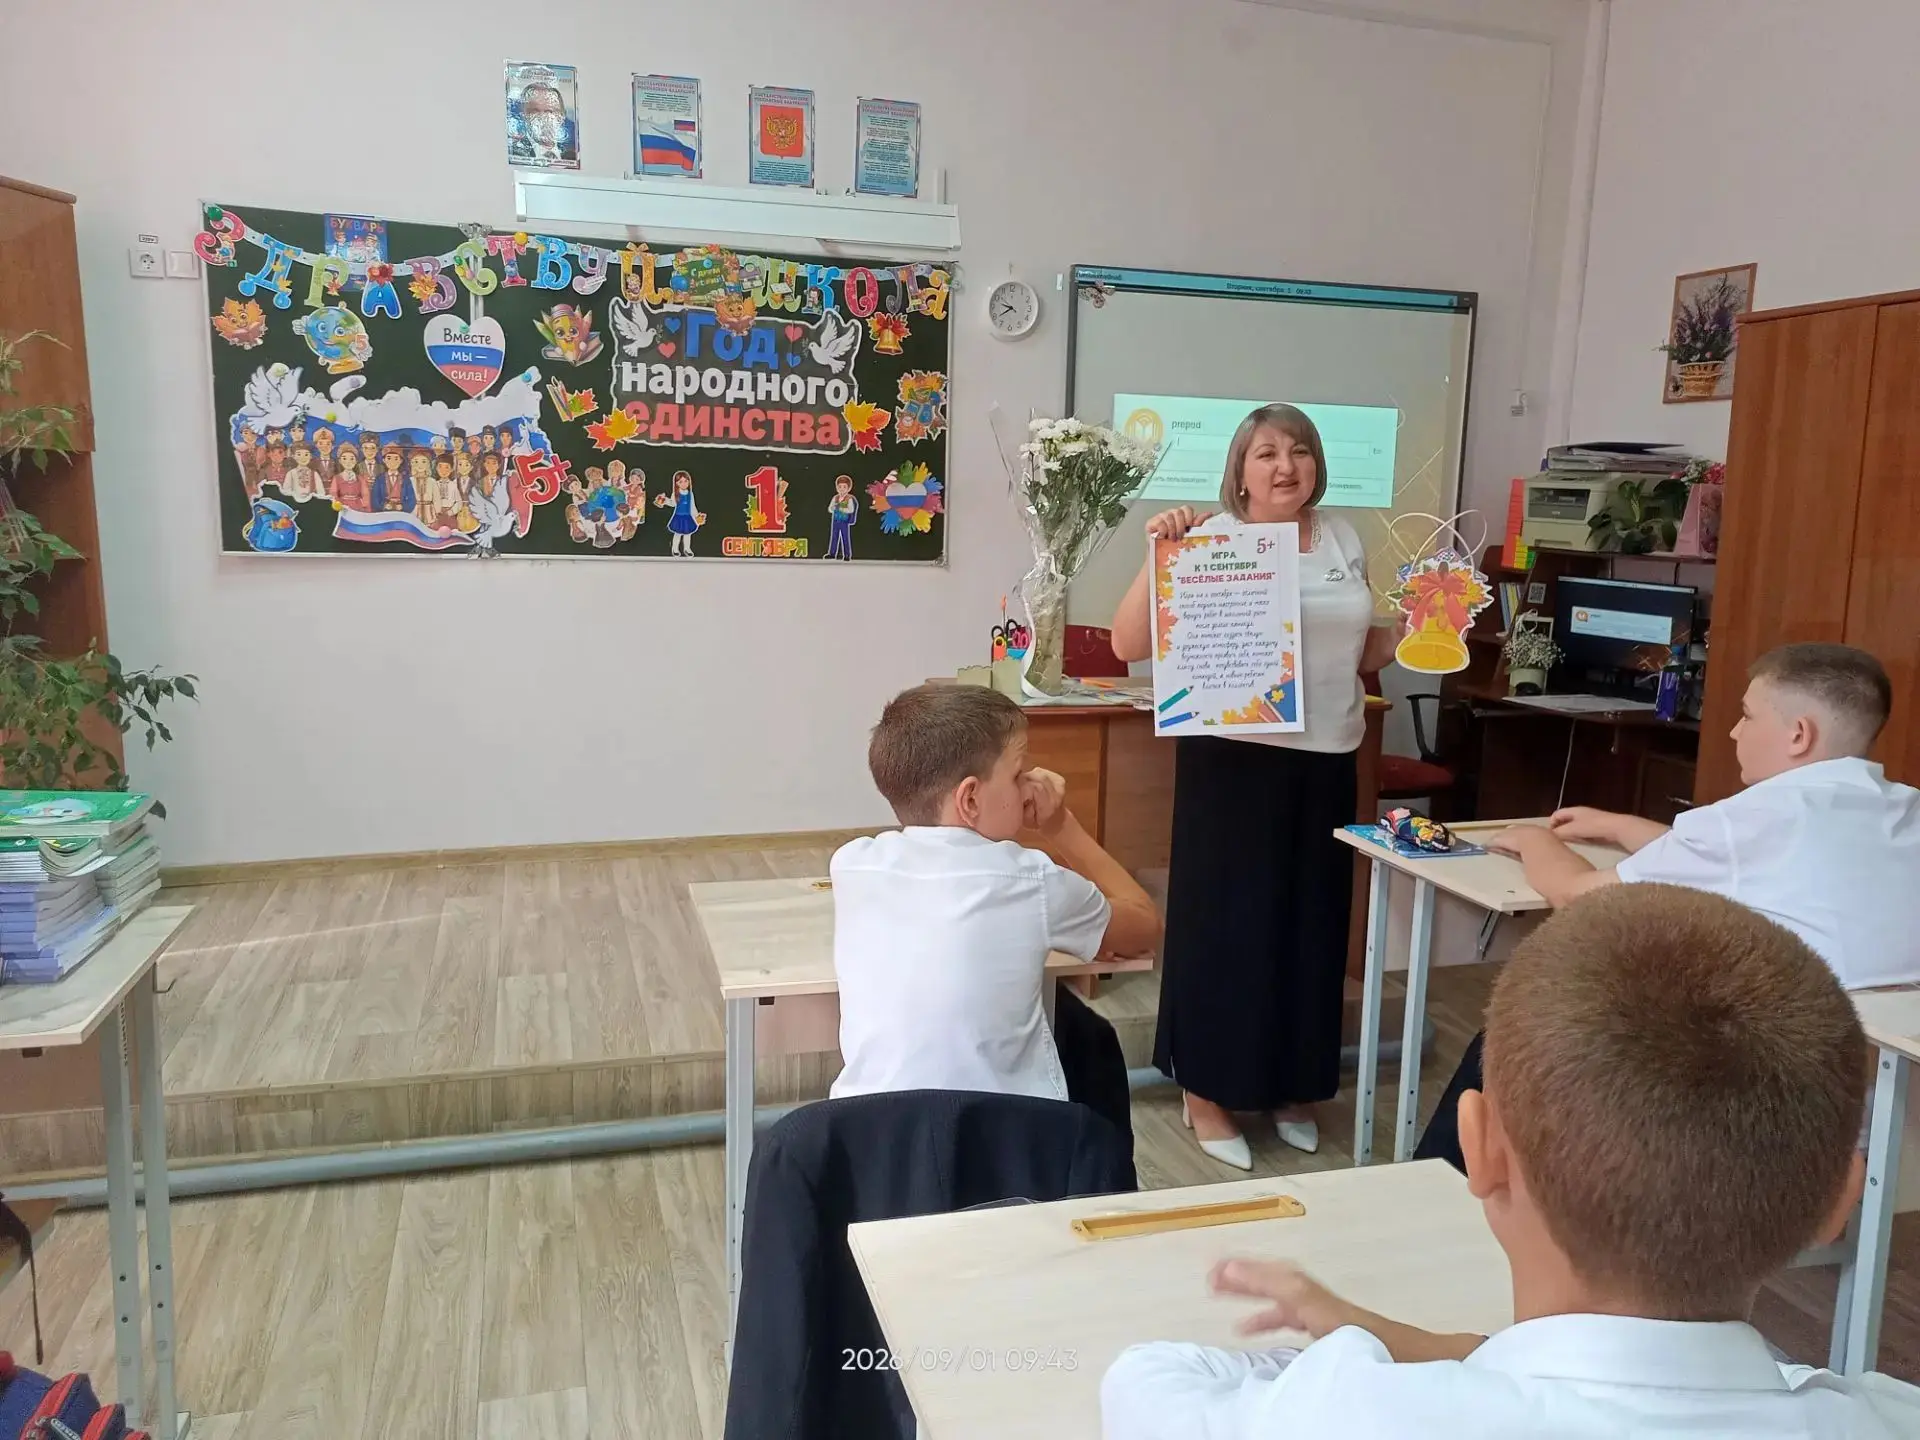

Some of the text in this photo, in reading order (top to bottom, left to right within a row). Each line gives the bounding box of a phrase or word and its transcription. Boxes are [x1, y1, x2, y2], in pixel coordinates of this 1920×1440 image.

[330, 217, 384, 233] БУКВАРЬ
[443, 327, 492, 346] Вместе
[683, 310, 779, 369] Год
[451, 350, 473, 363] мы
[450, 368, 488, 385] сила!
[621, 362, 850, 407] народного
[624, 400, 842, 447] единства
[745, 466, 789, 534] 1
[722, 537, 808, 557] СЕНТЯБРЯ
[1256, 537, 1276, 554] 5+
[1210, 562, 1257, 571] СЕНТЯБРЯ
[1226, 572, 1276, 582] ЗАДАНИЯ"
